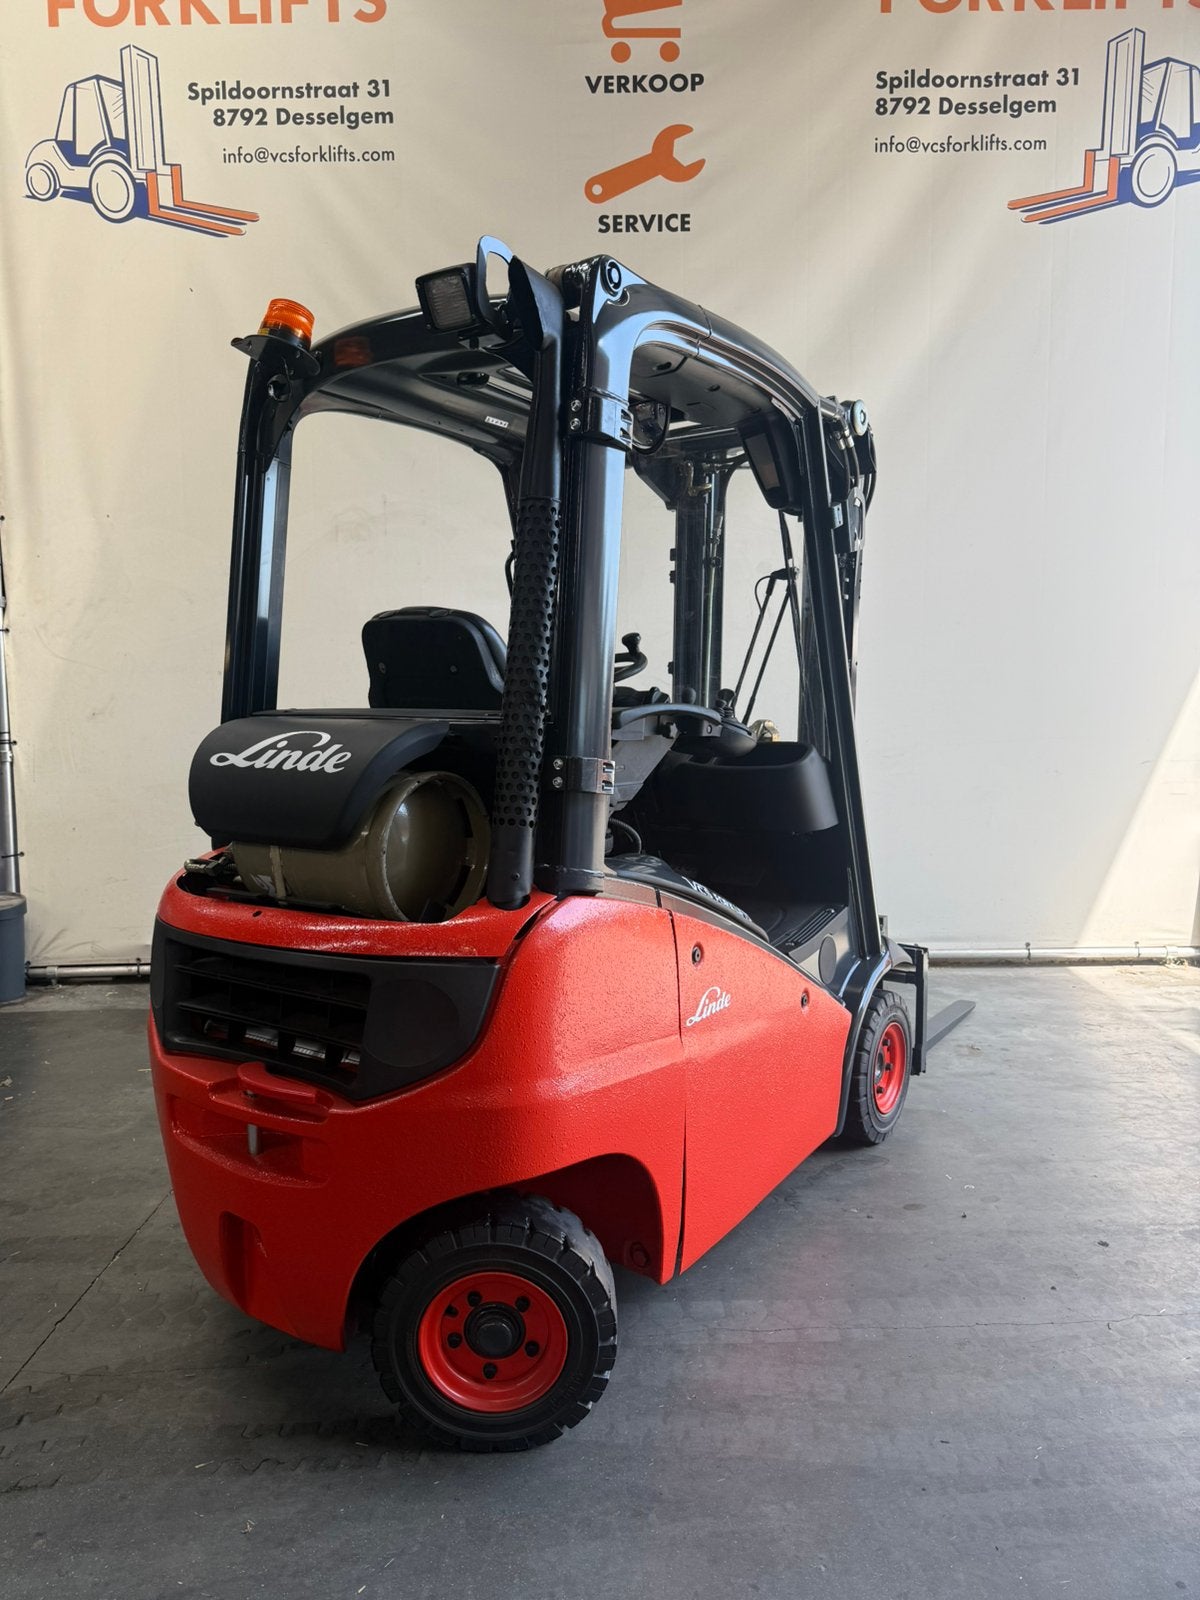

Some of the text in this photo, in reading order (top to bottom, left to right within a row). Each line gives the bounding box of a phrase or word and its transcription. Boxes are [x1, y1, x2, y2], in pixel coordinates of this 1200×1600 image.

[188, 79, 390, 104] Spildoornstraat 31
[585, 74, 704, 94] VERKOOP
[875, 68, 1080, 93] Spildoornstraat 31
[875, 95, 1057, 118] 8792 Desselgem
[213, 107, 394, 130] 8792 Desselgem
[222, 145, 395, 164] info@vcsforklifts.com
[874, 134, 1047, 153] info@vcsforklifts.com
[598, 213, 691, 233] SERVICE
[209, 730, 352, 774] Linde
[685, 985, 732, 1027] Linde
